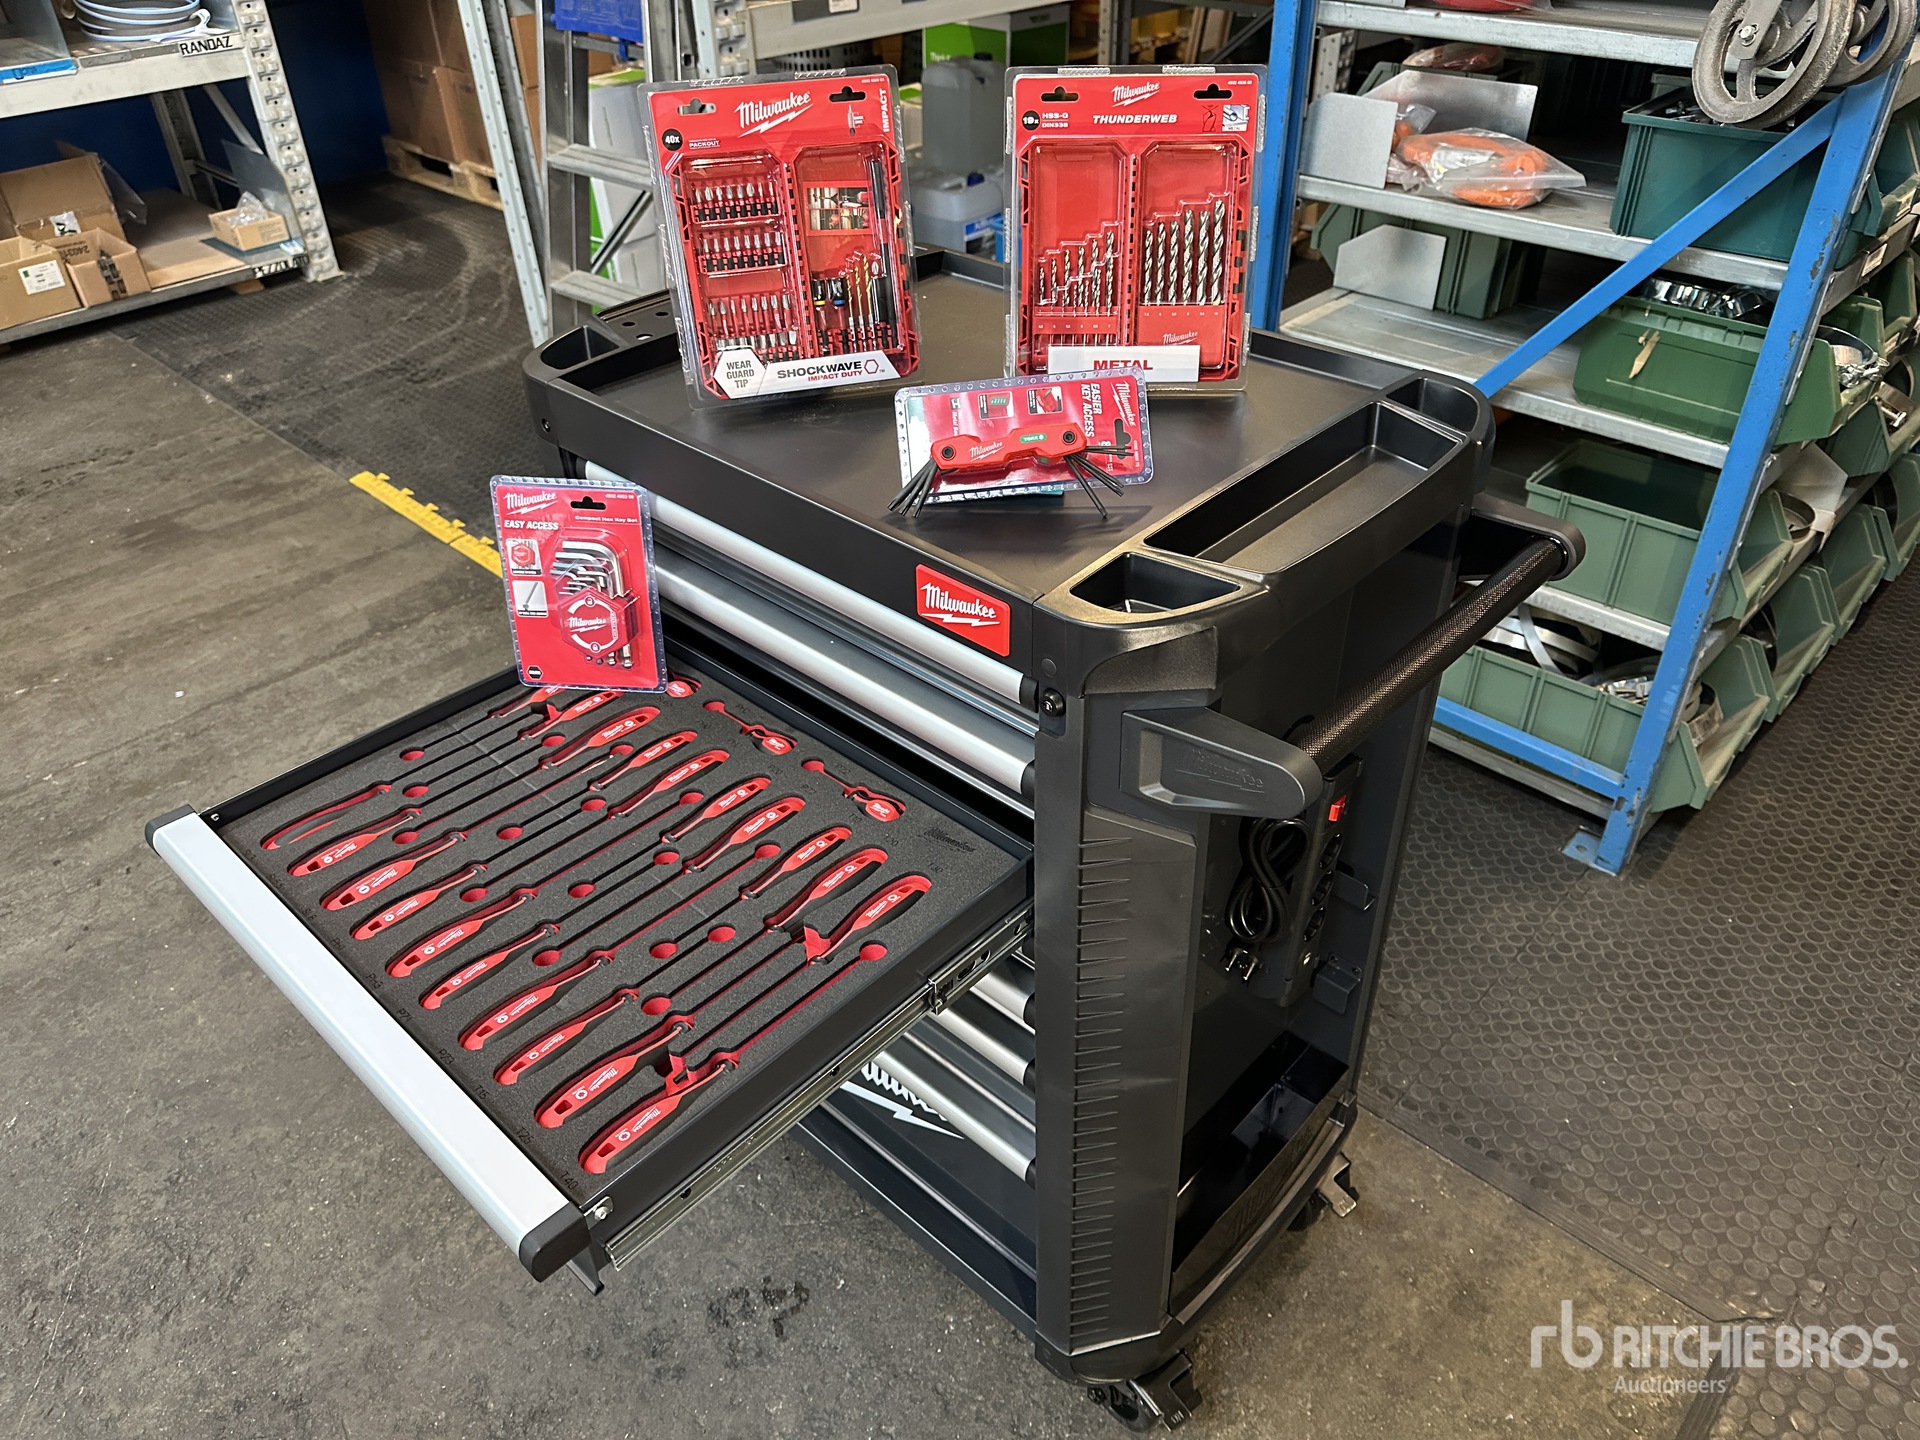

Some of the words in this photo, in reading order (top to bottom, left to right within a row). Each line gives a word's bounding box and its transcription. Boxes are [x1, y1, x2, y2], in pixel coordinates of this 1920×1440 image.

[179, 36, 233, 55] RANDAZ
[1111, 82, 1160, 102] Milwaukee
[734, 91, 812, 128] Milwaukee
[879, 88, 890, 132] IMPACT
[1022, 116, 1040, 125] 19x
[1092, 114, 1178, 124] THUNDERWEB
[664, 134, 680, 144] 40x
[689, 140, 720, 148] PACKOUT
[1163, 331, 1198, 345] Milwaukee
[726, 360, 752, 370] WEAR
[777, 361, 862, 379] SHOCKWAVE
[1093, 360, 1153, 371] METAL
[726, 369, 755, 379] GUARD
[808, 373, 839, 382] IMPACT
[841, 370, 863, 378] DUTY
[735, 378, 749, 388] TIP
[1080, 383, 1092, 402] KEY
[1090, 382, 1103, 415] EASIER
[1115, 380, 1136, 426] Milwaukee
[1082, 402, 1095, 438] ACCESS
[969, 441, 1003, 457] Milwaukee
[503, 491, 558, 509] Milwaukee
[504, 519, 526, 529] EASY
[526, 520, 559, 530] ACCESS
[920, 582, 997, 618] Milwaukee
[567, 617, 607, 628] Milwaukee
[475, 1085, 490, 1100] T15
[516, 1126, 536, 1145] T25
[560, 1170, 580, 1191] T40
